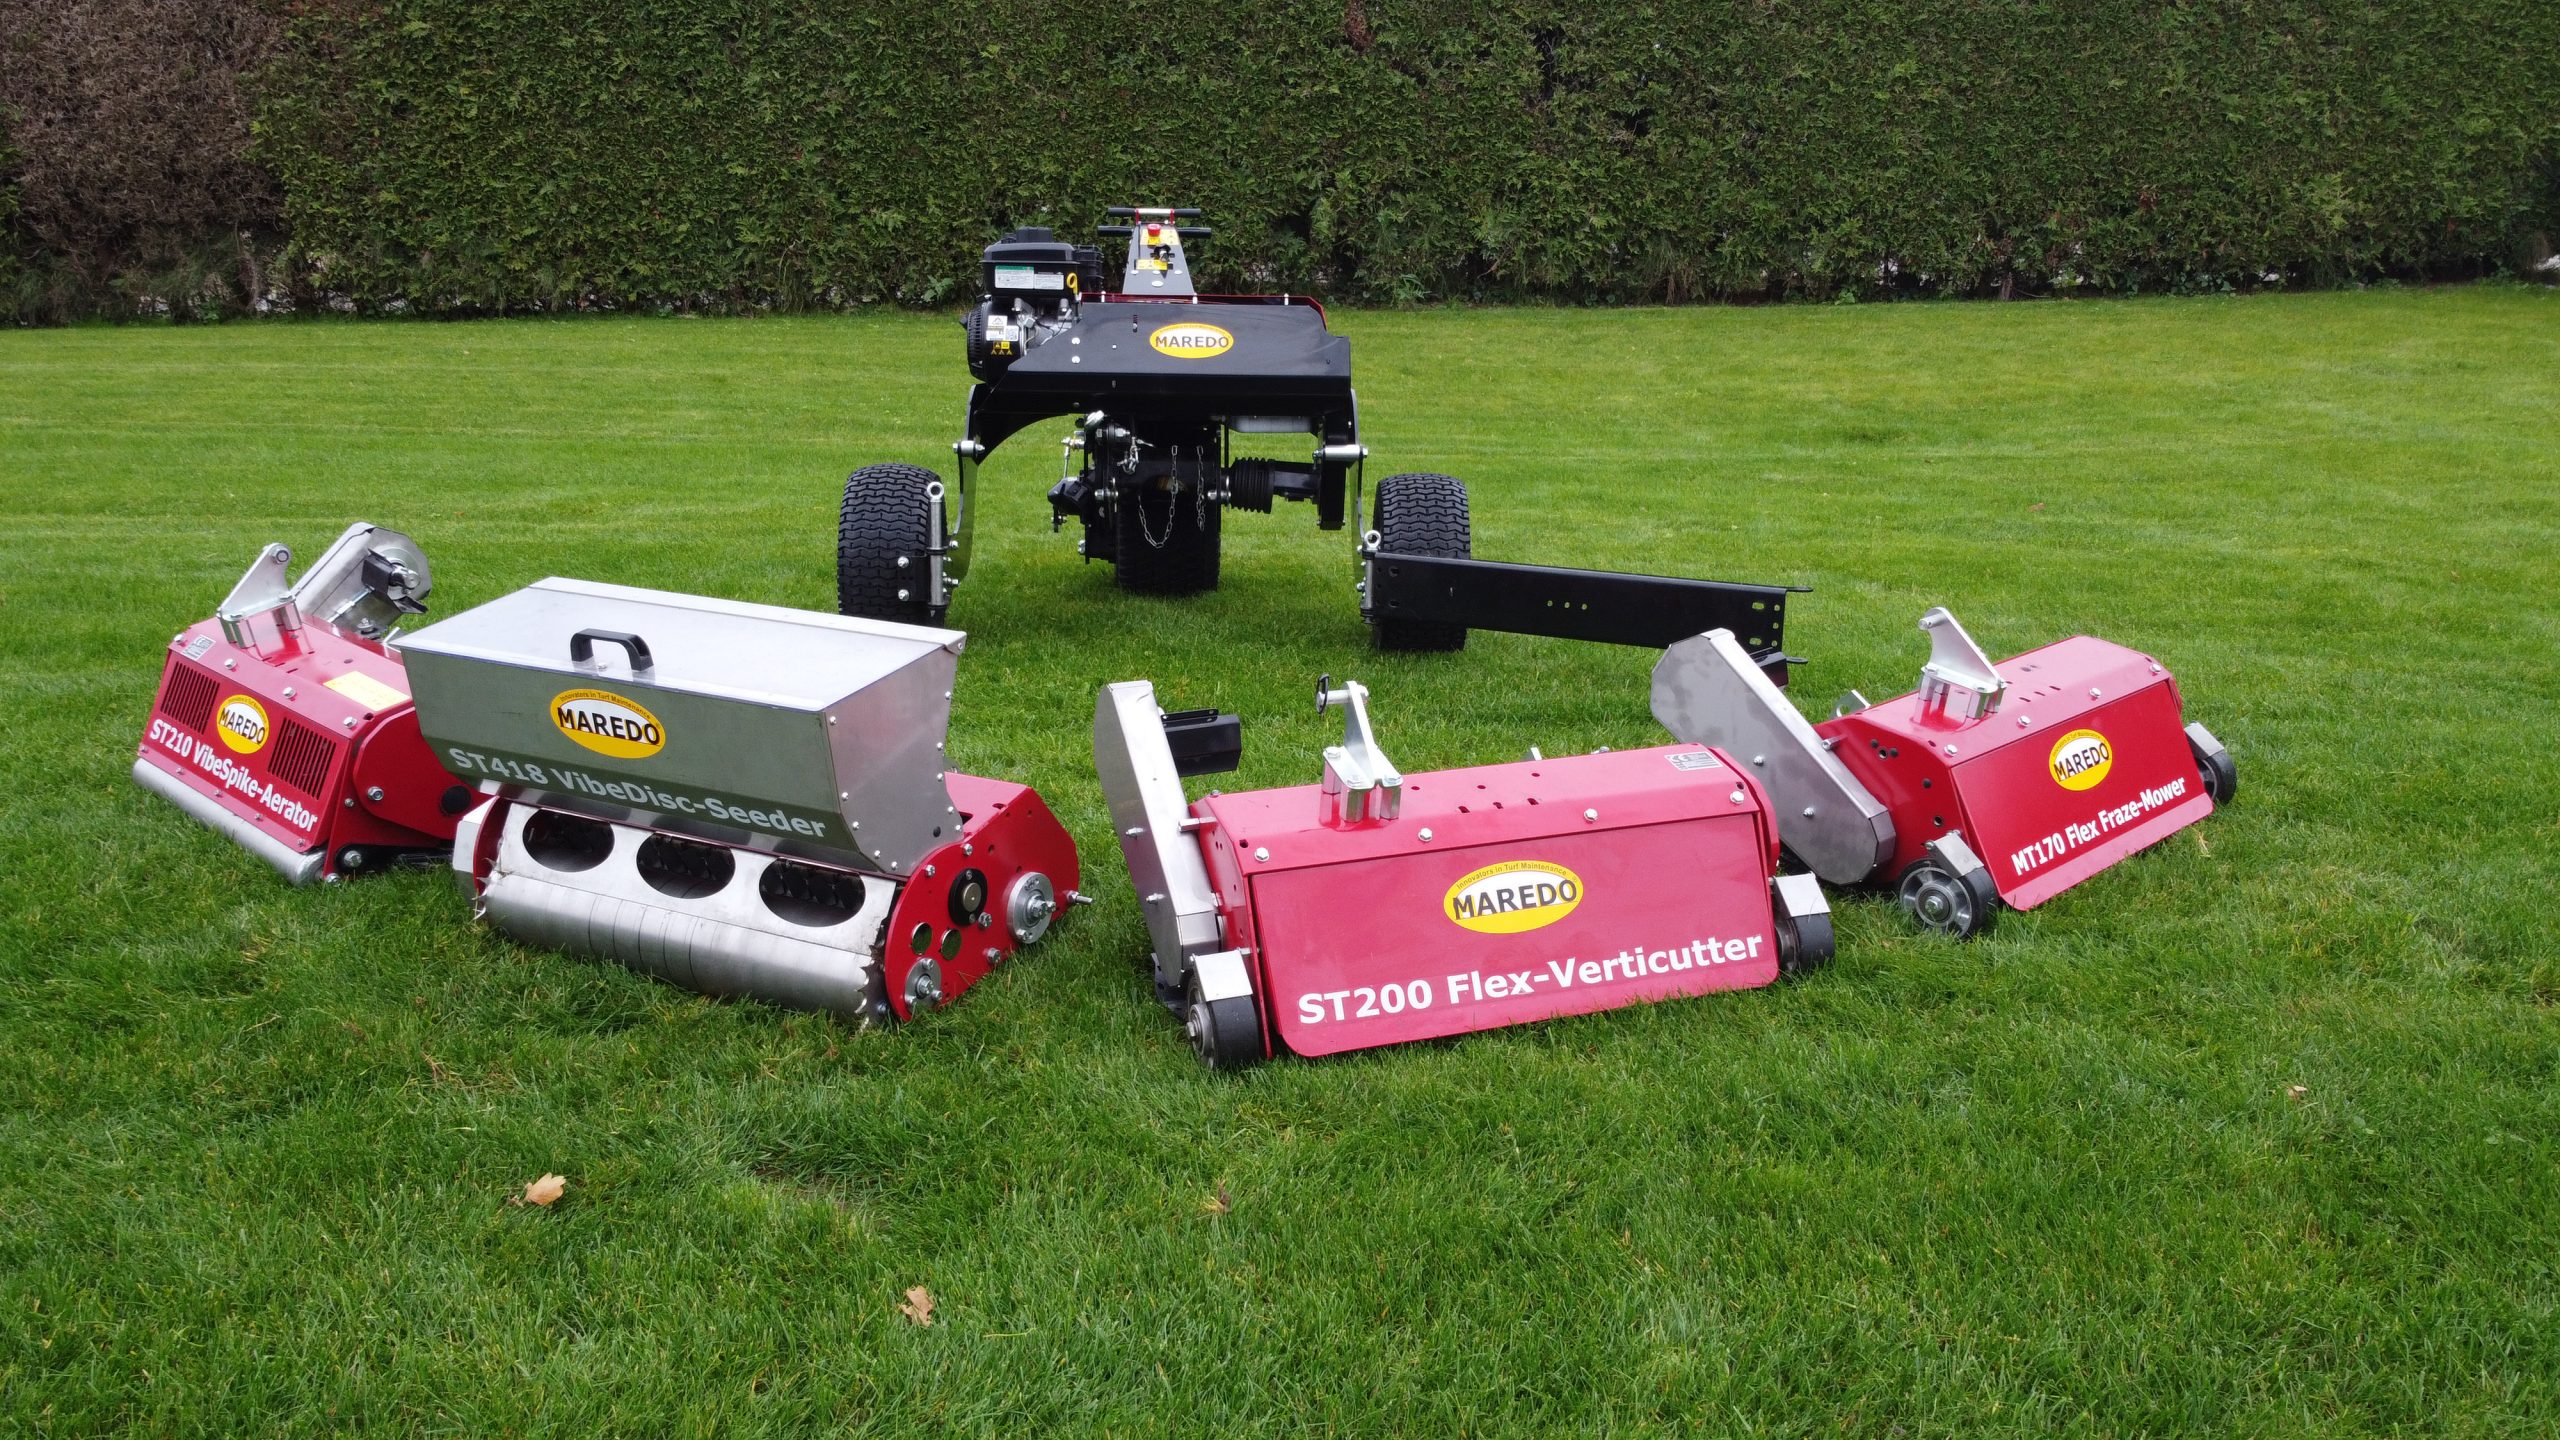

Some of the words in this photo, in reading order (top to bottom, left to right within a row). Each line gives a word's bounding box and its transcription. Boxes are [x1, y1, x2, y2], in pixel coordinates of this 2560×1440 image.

[1155, 335, 1230, 349] MAREDO
[597, 692, 610, 700] Turf
[218, 707, 266, 745] MAREDO
[557, 706, 660, 746] MAREDO
[150, 719, 193, 758] ST210
[193, 739, 318, 832] VibeSpike-Aerator
[2053, 742, 2110, 782] MAREDO
[449, 747, 549, 786] ST418
[549, 767, 827, 838] VibeDisc-Seeder
[2010, 832, 2066, 876] MT170
[2064, 819, 2101, 849] Flex
[2097, 777, 2186, 833] Fraze-Mower
[1456, 868, 1494, 890] Innovators
[1520, 862, 1567, 876] Maintenance
[1453, 879, 1577, 920] MAREDO
[1297, 978, 1433, 1025] ST200
[1447, 933, 1764, 1005] Flex-Verticutter
